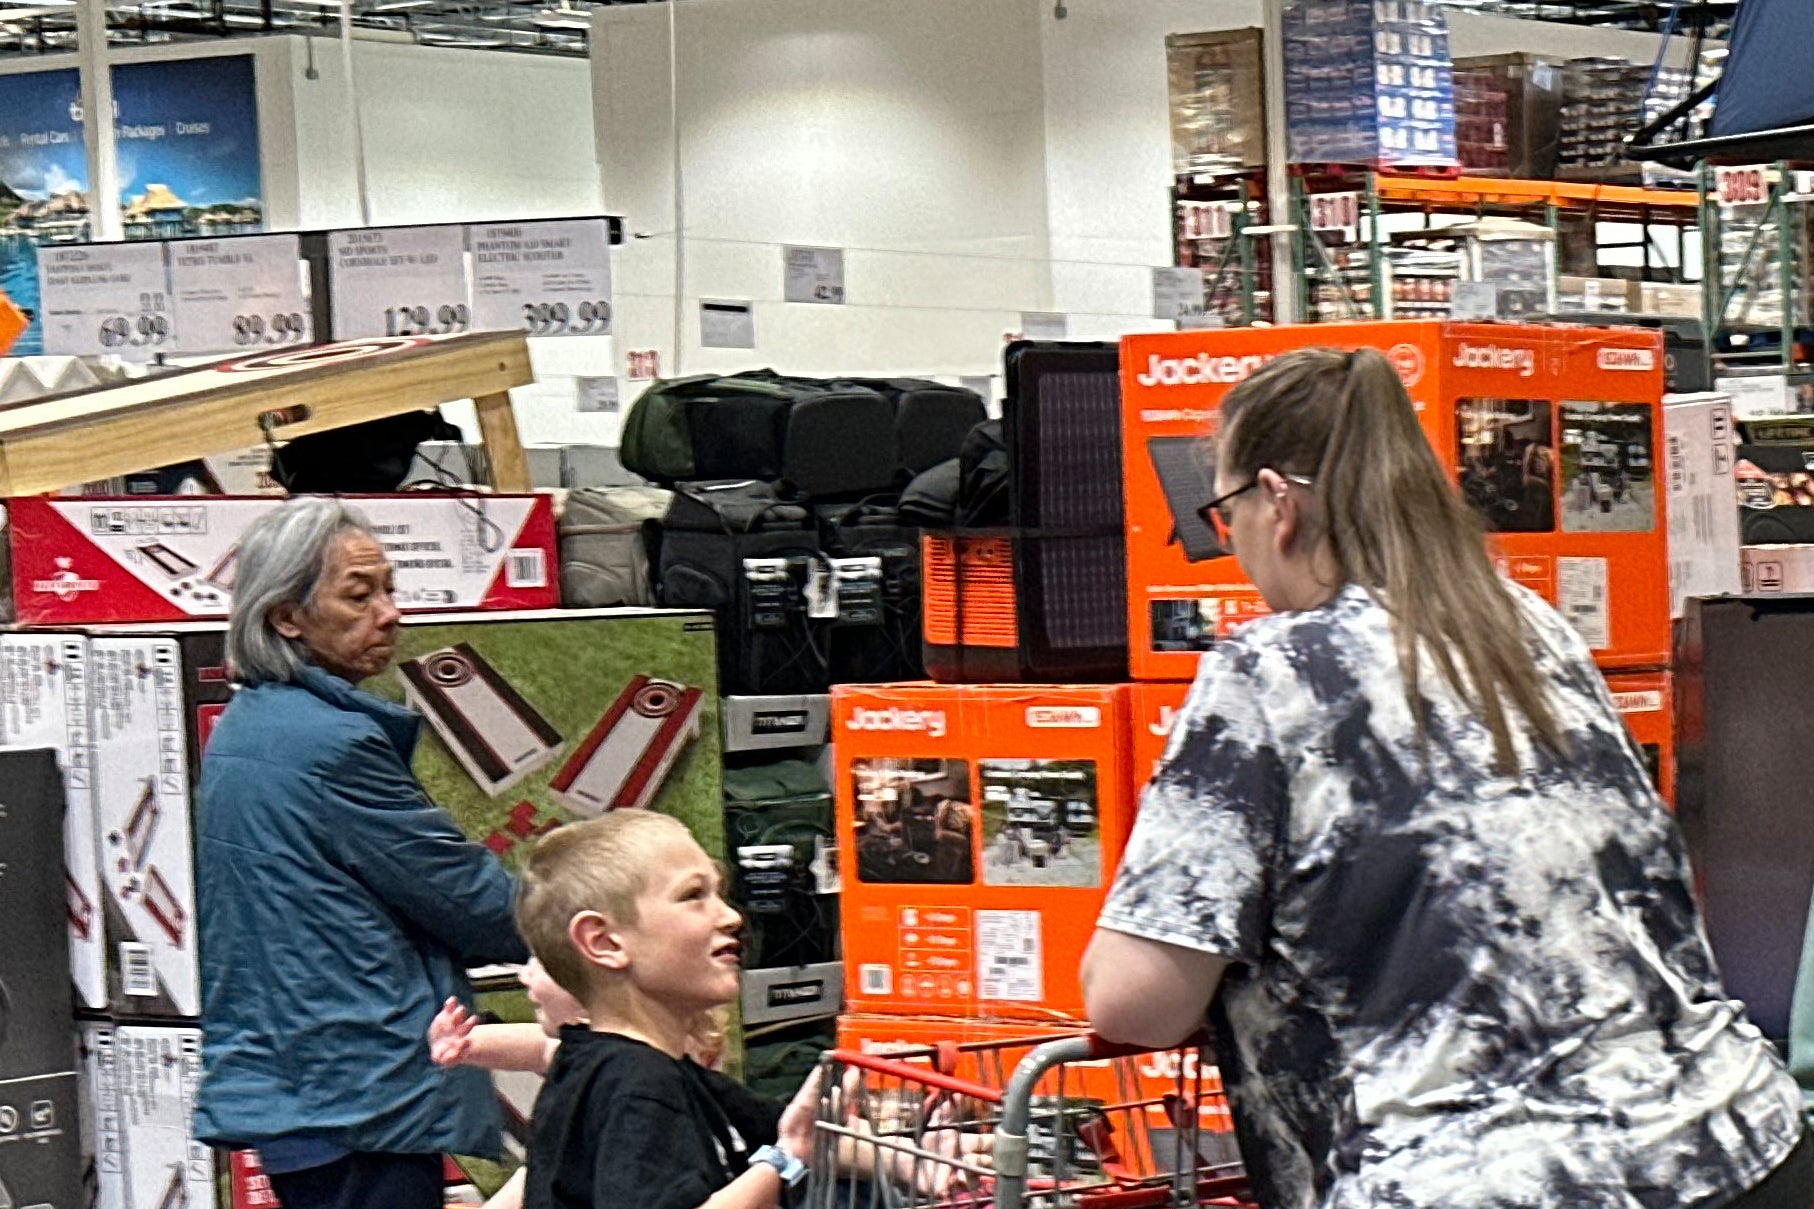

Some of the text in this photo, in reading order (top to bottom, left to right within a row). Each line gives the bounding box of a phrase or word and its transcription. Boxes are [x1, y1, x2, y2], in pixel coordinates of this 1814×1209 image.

[176, 122, 211, 135] Cruises
[478, 240, 522, 251] PHANTOM
[478, 250, 564, 262] ELECTRIC SCOOTER
[232, 312, 304, 345] 89.99
[384, 303, 470, 336] 129.99
[522, 300, 611, 335] 399.99
[1137, 352, 1266, 386] Jacker
[1453, 342, 1535, 377] Jackery
[845, 706, 947, 737] Jackery
